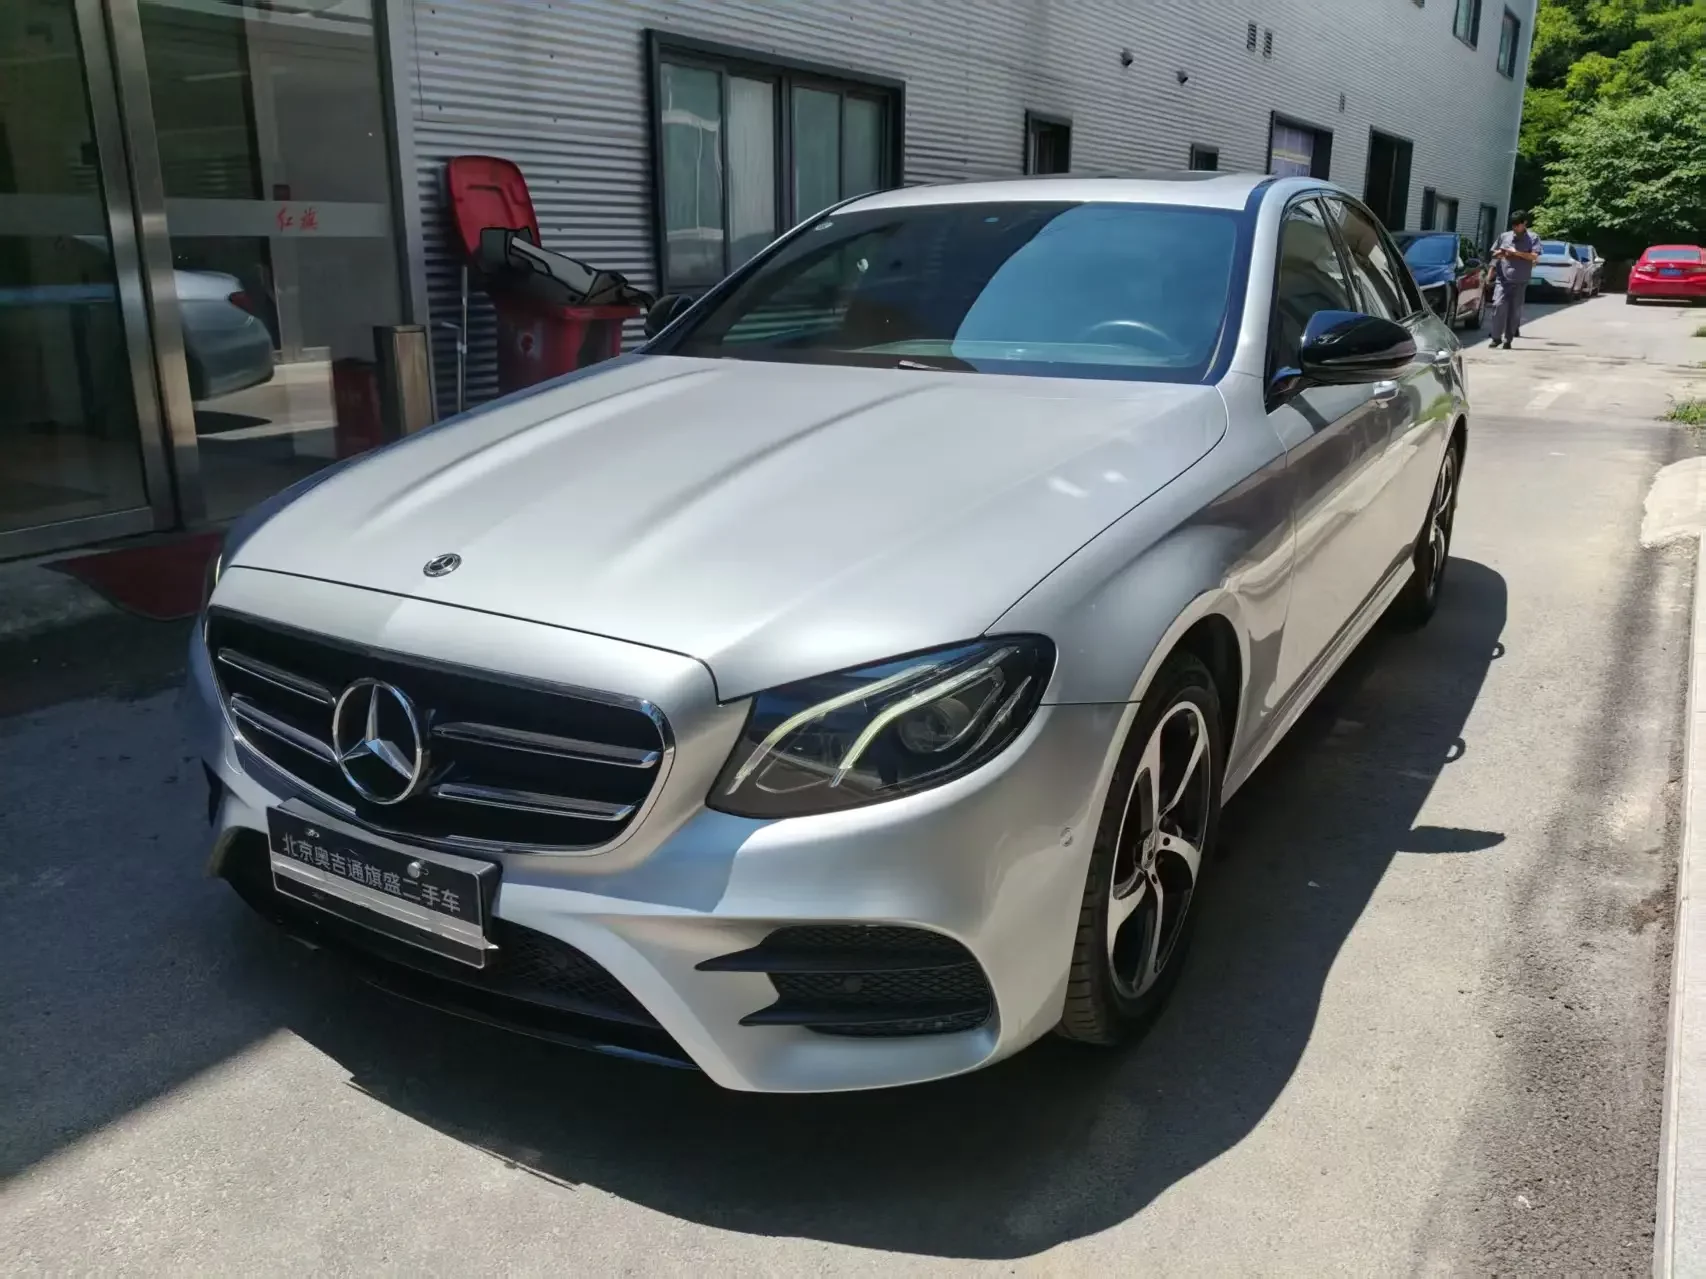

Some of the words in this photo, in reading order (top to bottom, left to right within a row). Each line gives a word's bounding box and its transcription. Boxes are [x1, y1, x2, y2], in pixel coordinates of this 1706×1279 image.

[282, 832, 461, 913] 北京奥吉通旗盛二手车
